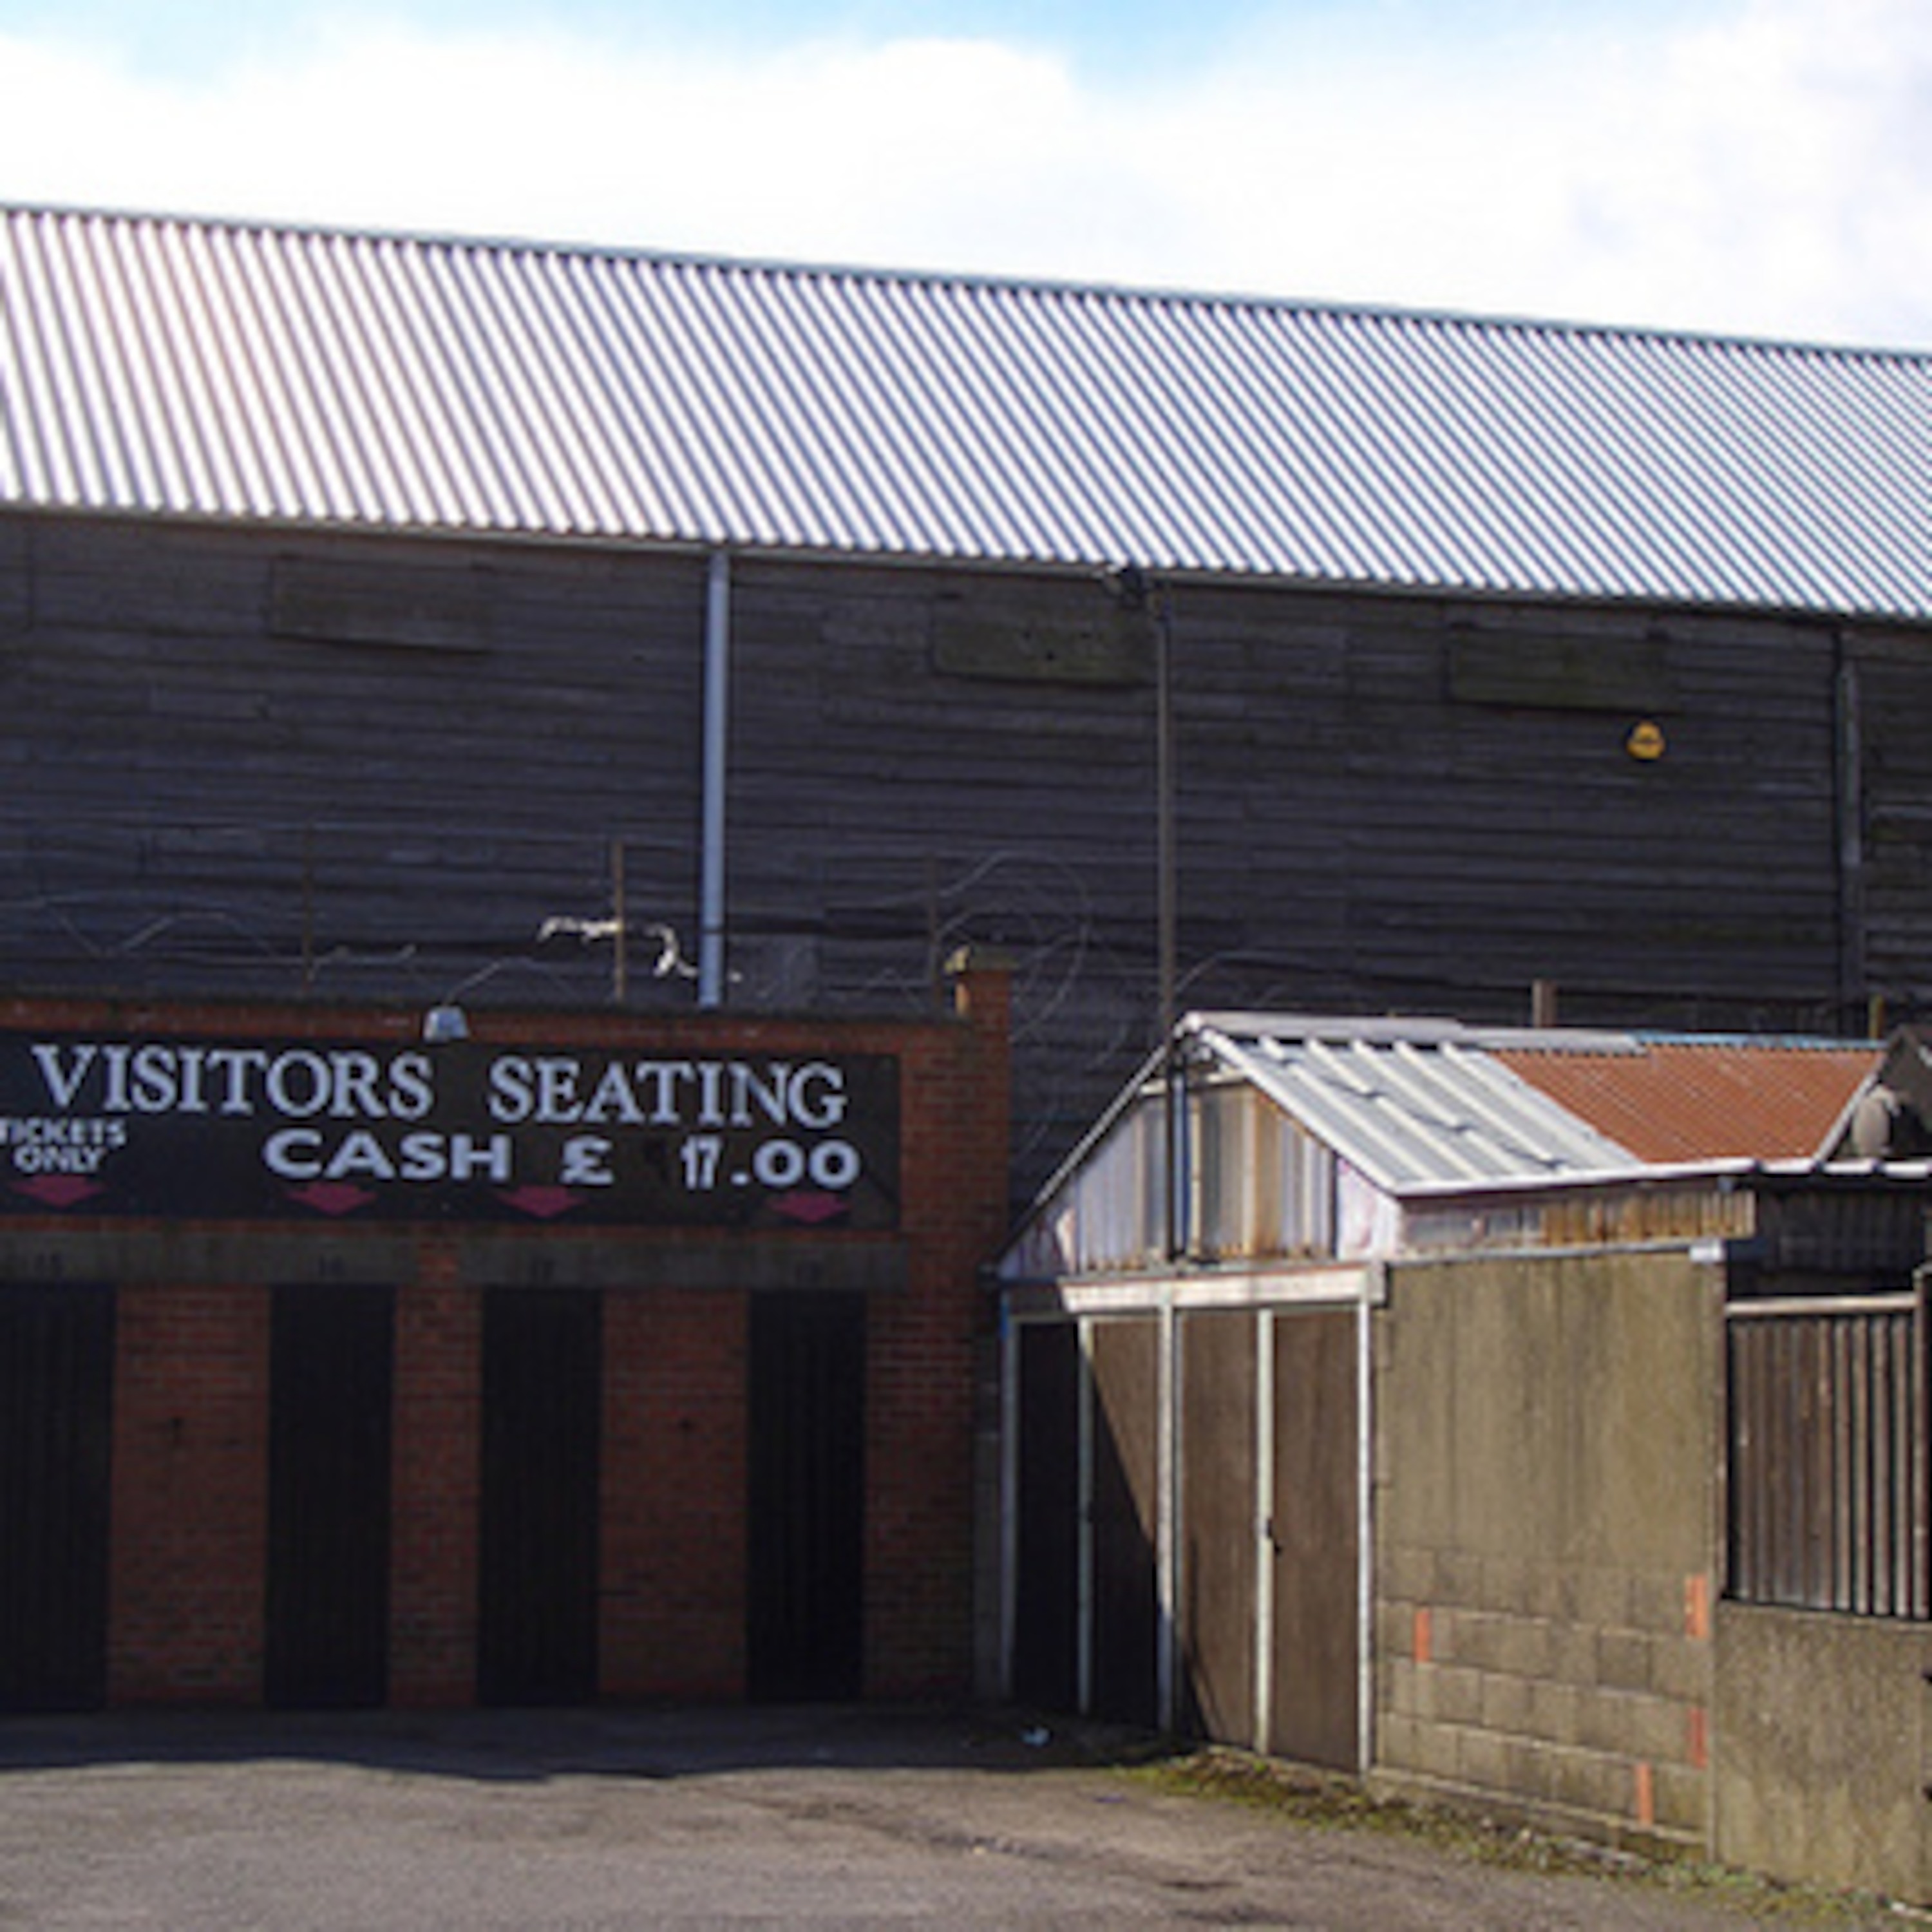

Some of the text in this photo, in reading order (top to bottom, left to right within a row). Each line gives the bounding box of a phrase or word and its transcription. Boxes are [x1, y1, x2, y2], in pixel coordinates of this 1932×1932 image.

[30, 1044, 848, 1128] VISITORS SEATING
[0, 1117, 128, 1147] TICKETS
[14, 1145, 108, 1173] ONLY
[263, 1127, 860, 1189] CASH £ 17.00
